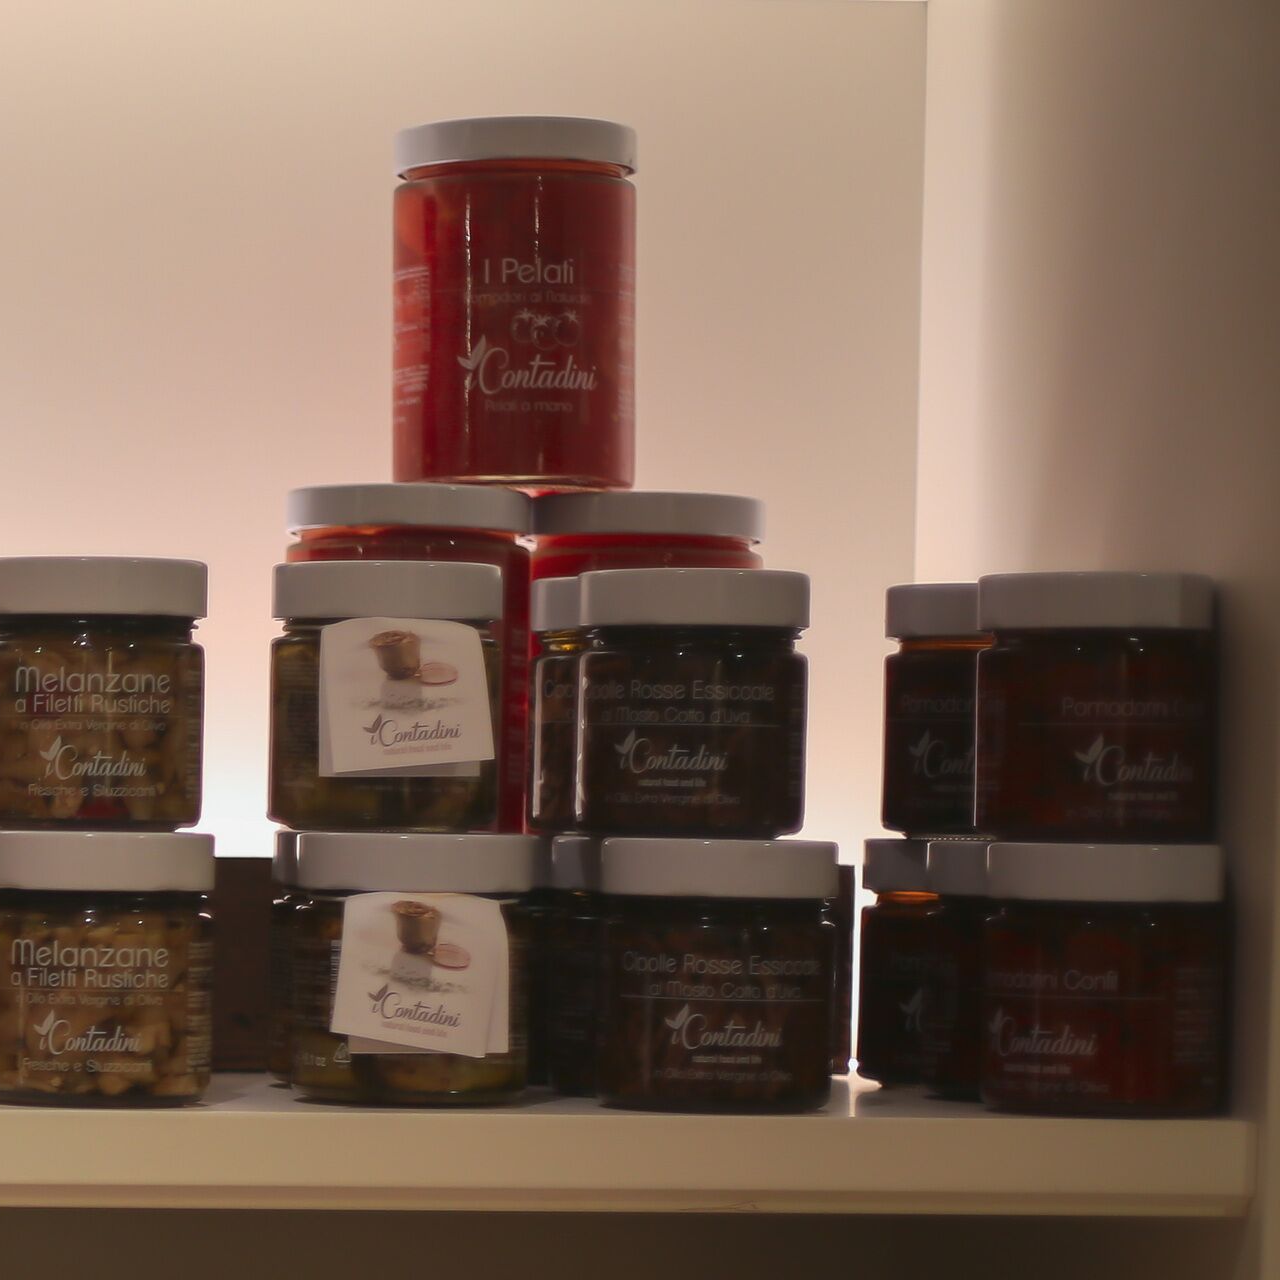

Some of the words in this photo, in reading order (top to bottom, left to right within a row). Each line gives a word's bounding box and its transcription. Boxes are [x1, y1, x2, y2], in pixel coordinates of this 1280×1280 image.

[501, 257, 576, 285] Pelati
[14, 664, 171, 695] Melanzane
[14, 697, 28, 713] a
[10, 938, 170, 969] Melanzane
[10, 970, 23, 987] a
[83, 968, 170, 989] Rustiche
